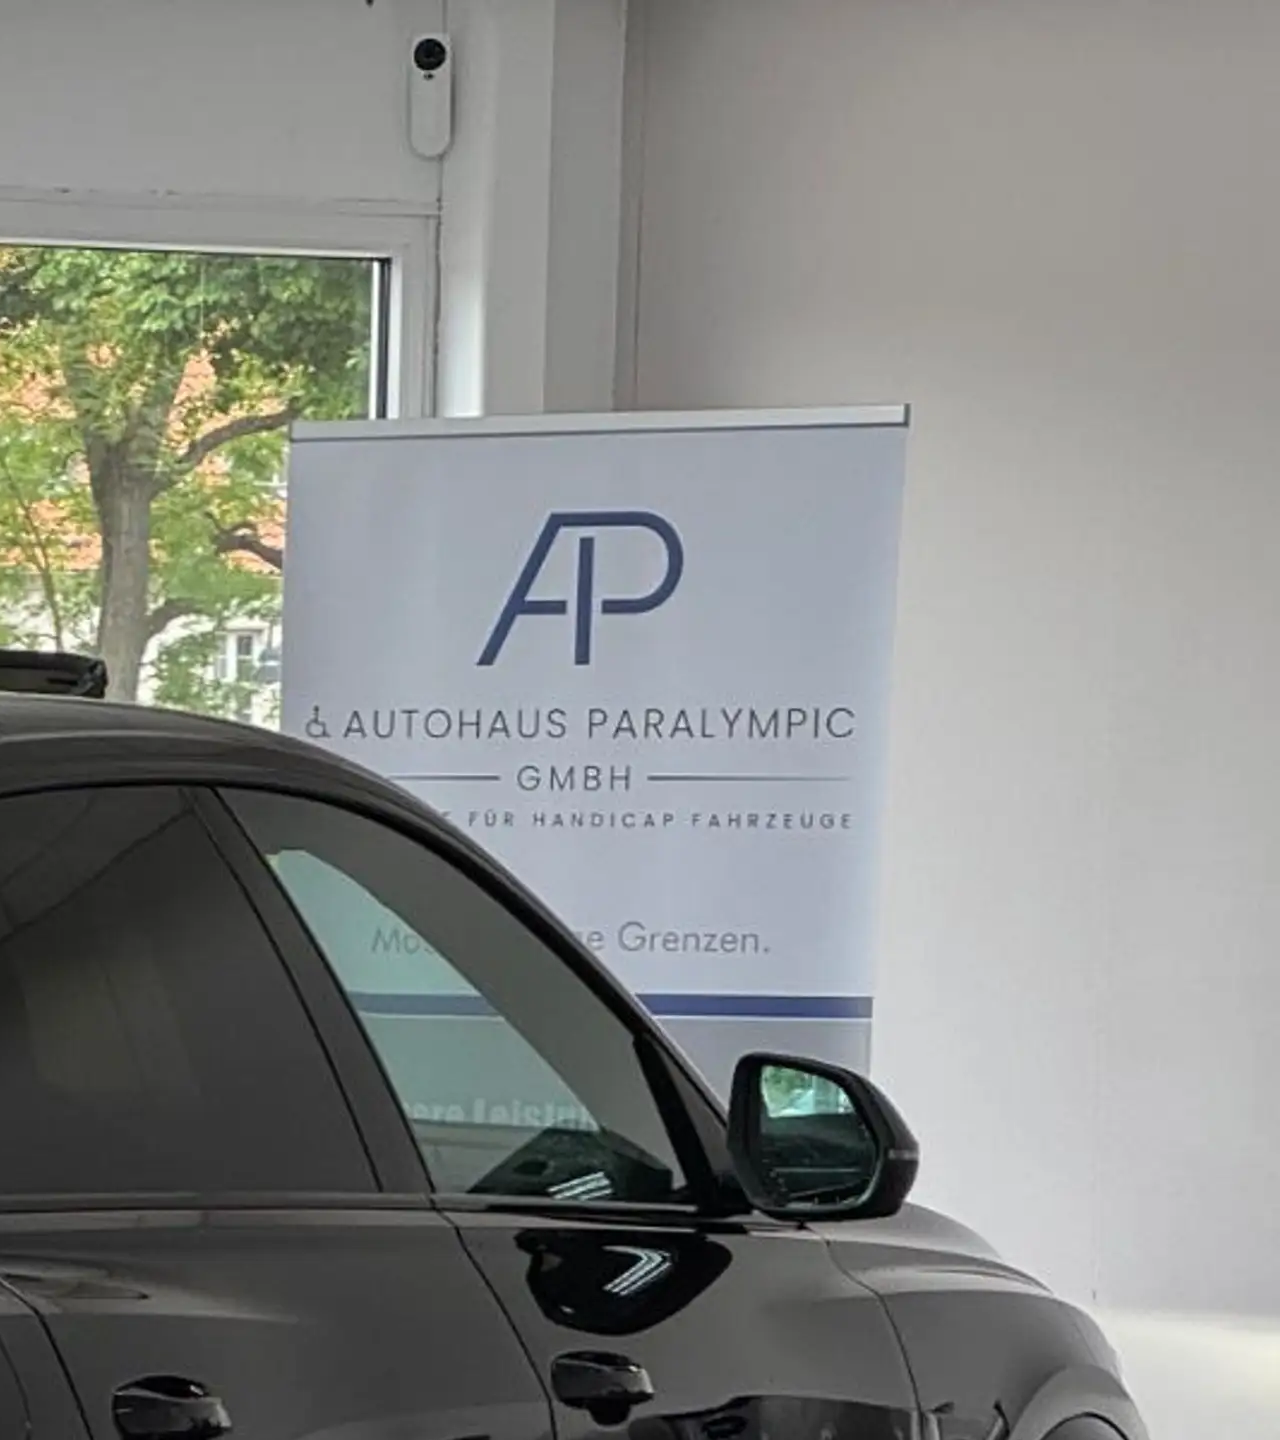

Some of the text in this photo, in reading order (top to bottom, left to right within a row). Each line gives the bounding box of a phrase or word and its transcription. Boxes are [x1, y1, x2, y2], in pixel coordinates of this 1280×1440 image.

[475, 510, 684, 667] AP
[342, 706, 855, 740] AUTOHAUS PARALYMPIC
[516, 764, 631, 792] GMBH
[468, 808, 514, 828] FÜR
[533, 811, 674, 829] HANDICAP
[691, 812, 852, 830] FAHRZEUGE
[617, 920, 770, 954] Grenzen.
